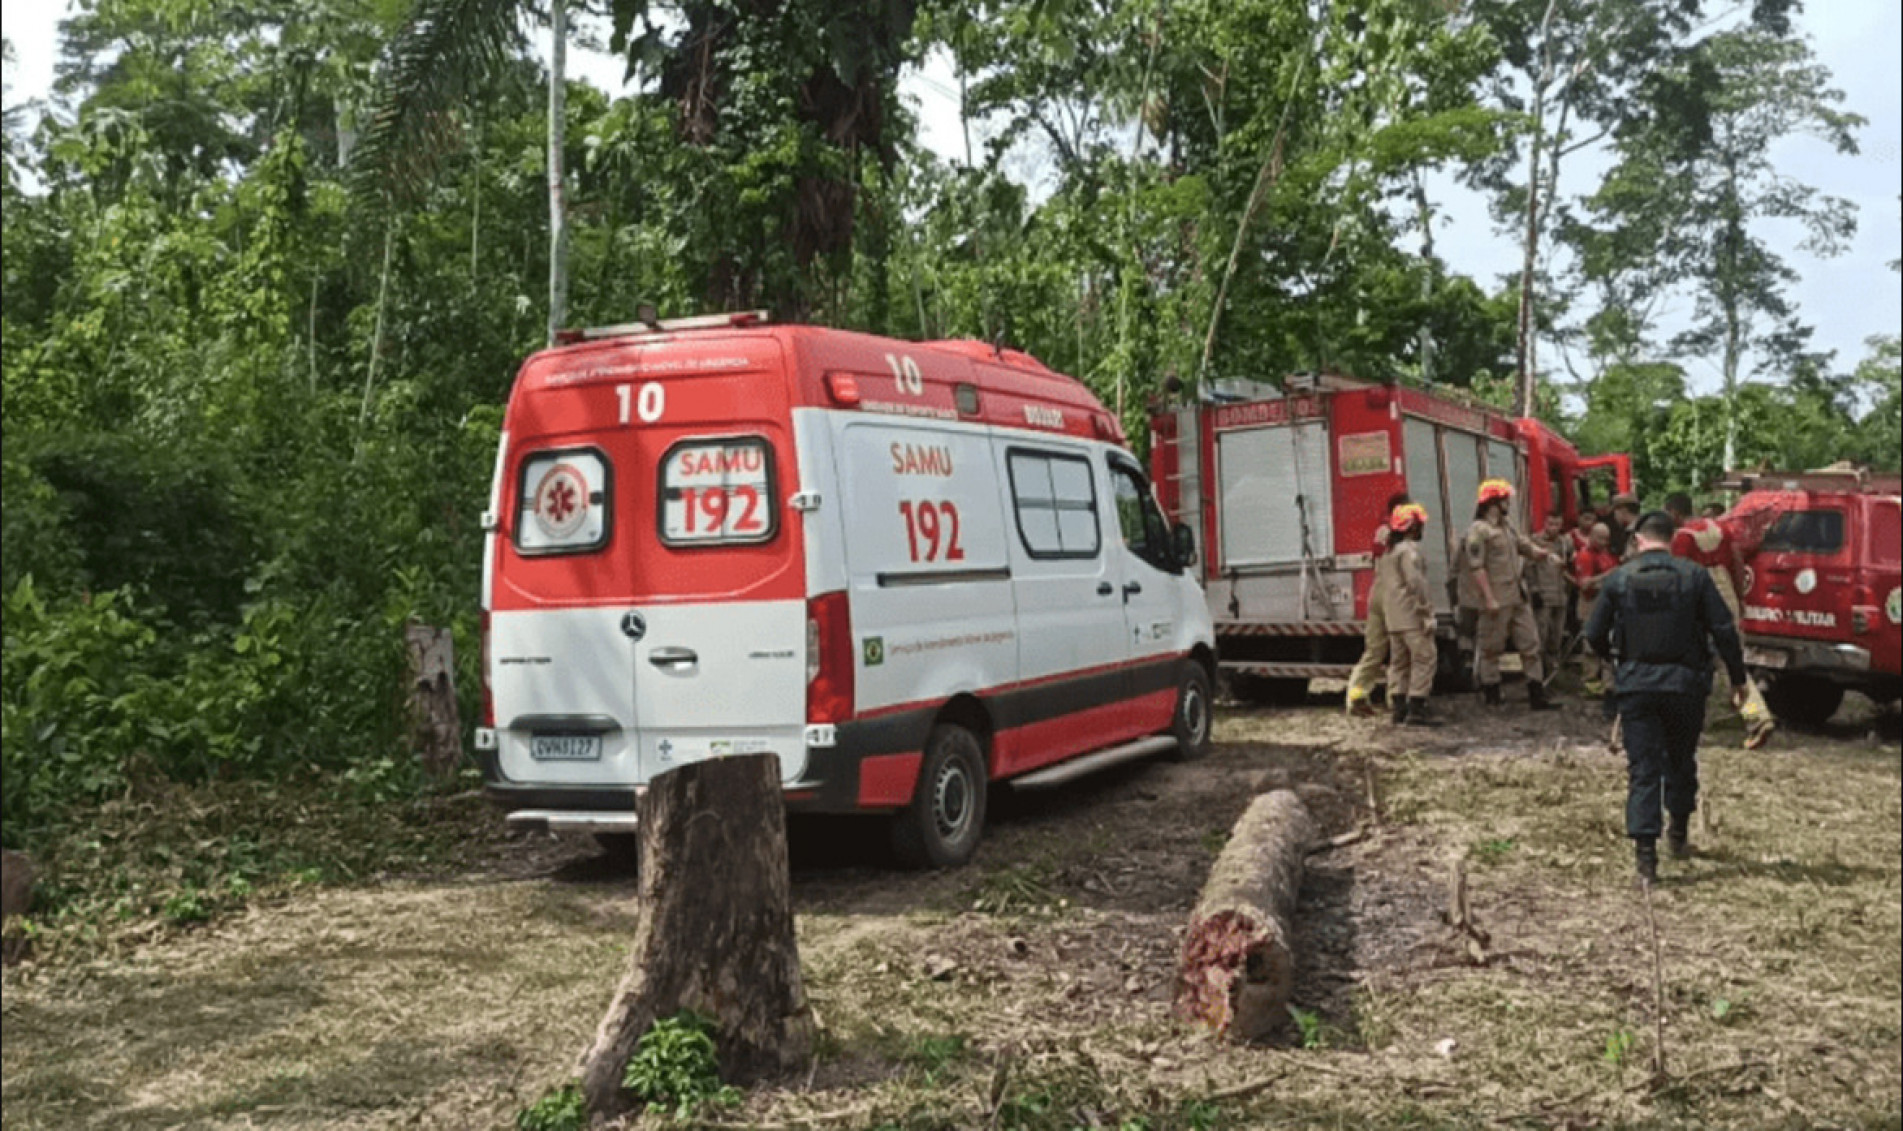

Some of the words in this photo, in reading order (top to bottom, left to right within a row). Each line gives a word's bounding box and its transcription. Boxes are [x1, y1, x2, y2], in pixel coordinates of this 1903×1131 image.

[885, 354, 923, 396] 10
[616, 382, 665, 424] 10
[680, 449, 763, 476] SAMU
[889, 442, 952, 476] SAMU
[680, 484, 763, 533] 192
[899, 500, 964, 562] 192
